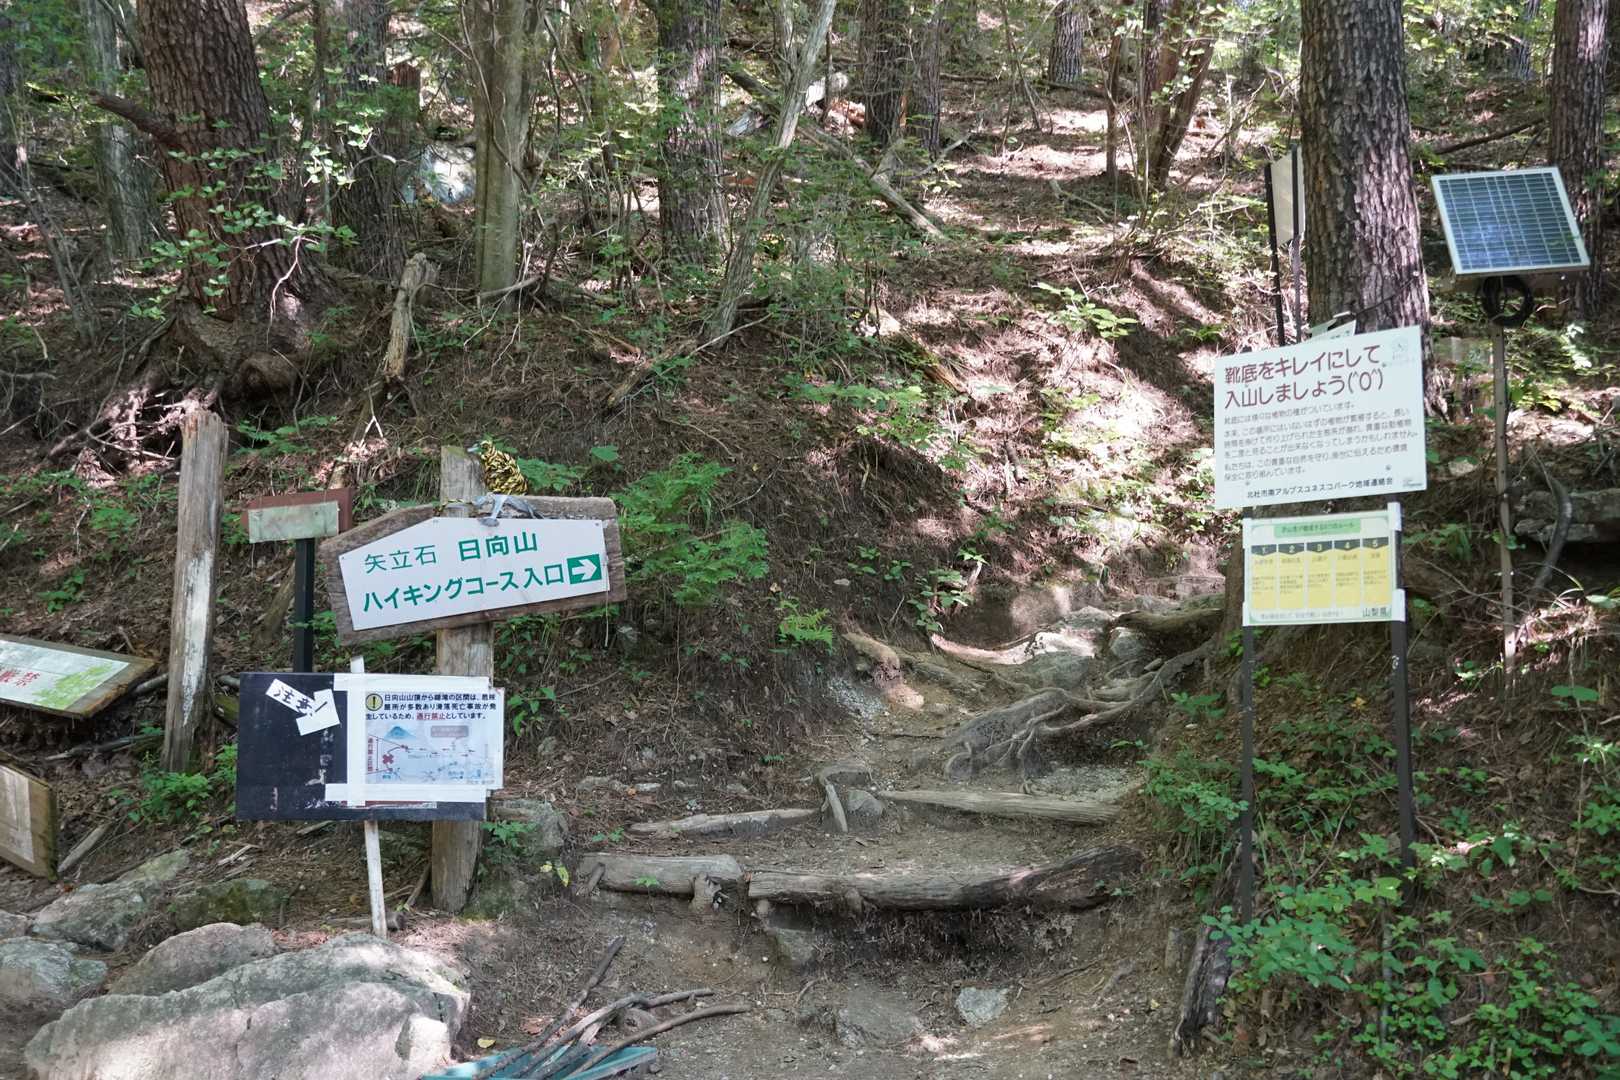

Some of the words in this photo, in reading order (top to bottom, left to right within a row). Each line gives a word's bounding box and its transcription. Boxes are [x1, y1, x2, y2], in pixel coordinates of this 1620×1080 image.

[1224, 344, 1381, 384] 靴底をキレイにして
[364, 544, 437, 573] 矢立石
[459, 531, 538, 562] 日向山
[362, 563, 565, 612] ハイキングコース入口
[1362, 607, 1388, 618] 山梨県
